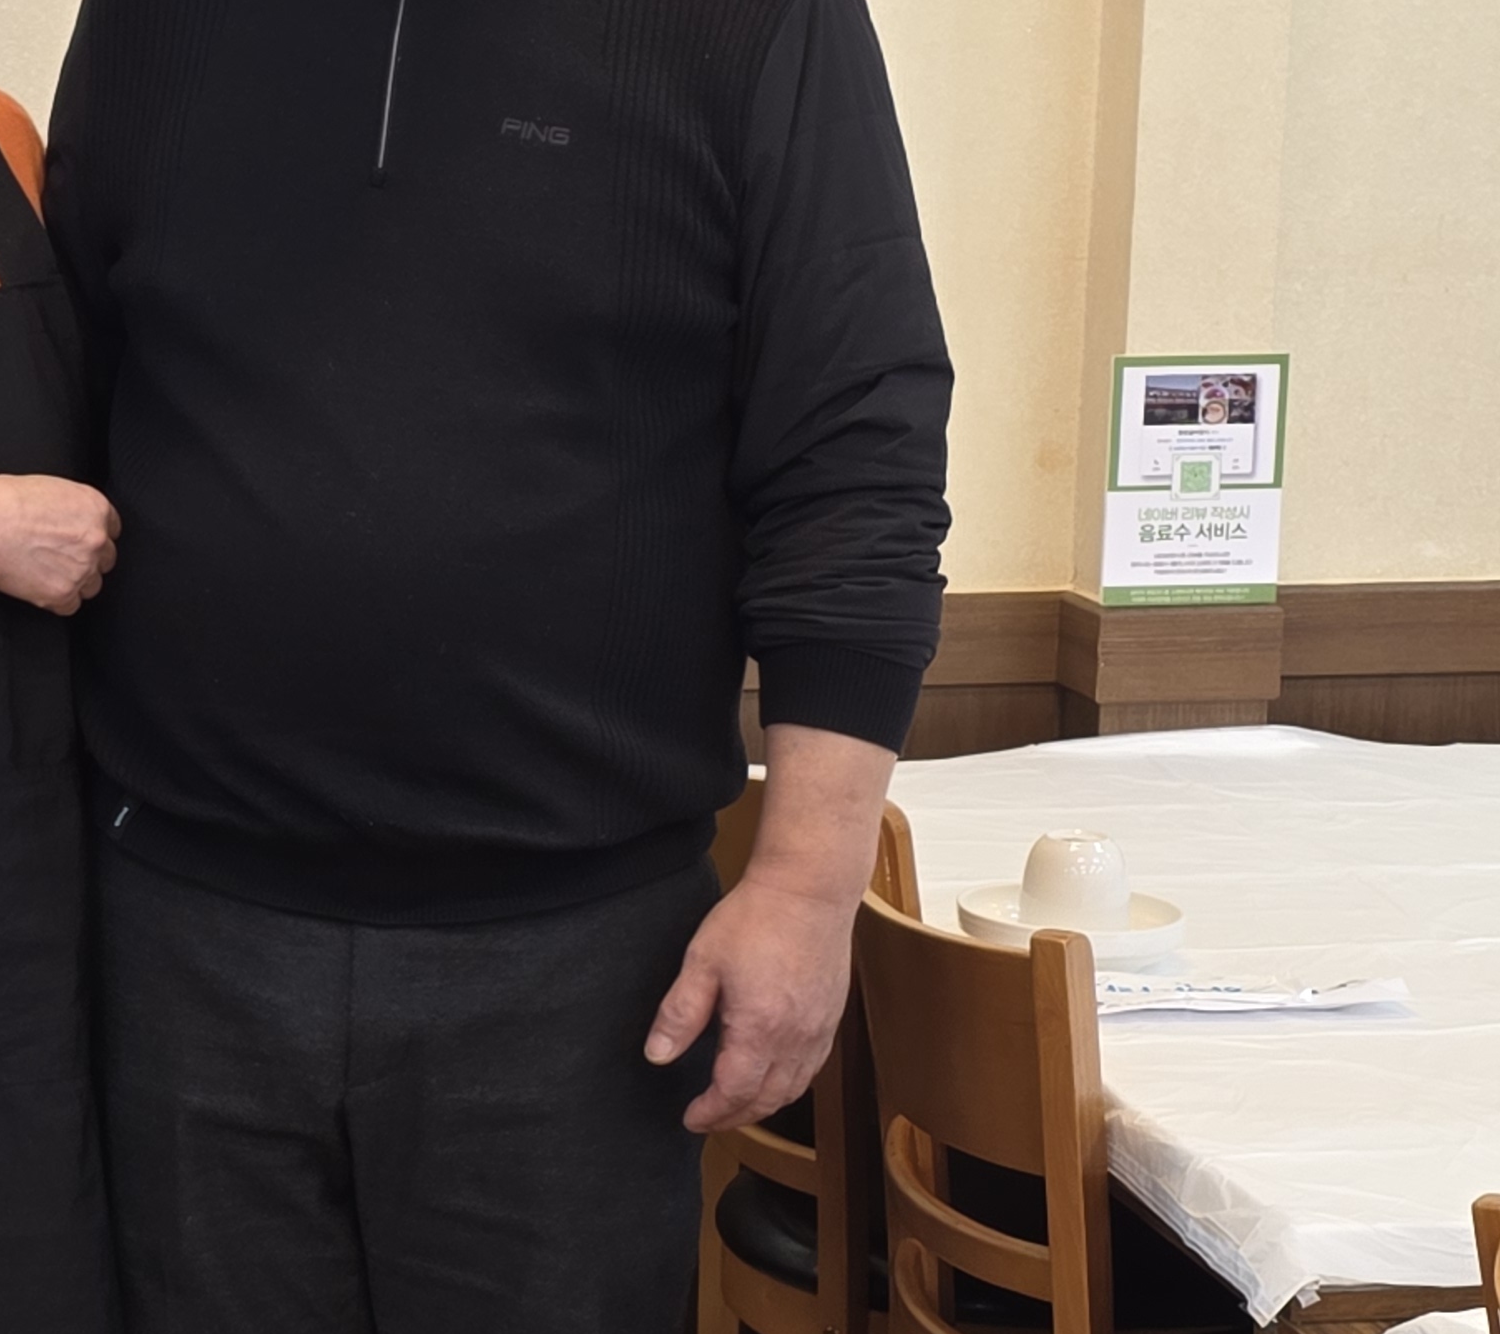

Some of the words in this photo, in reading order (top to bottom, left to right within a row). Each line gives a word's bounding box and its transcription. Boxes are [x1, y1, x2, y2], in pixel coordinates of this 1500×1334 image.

[501, 117, 571, 145] PING
[1138, 523, 1191, 543] 음료수
[1195, 522, 1248, 541] 서비스
